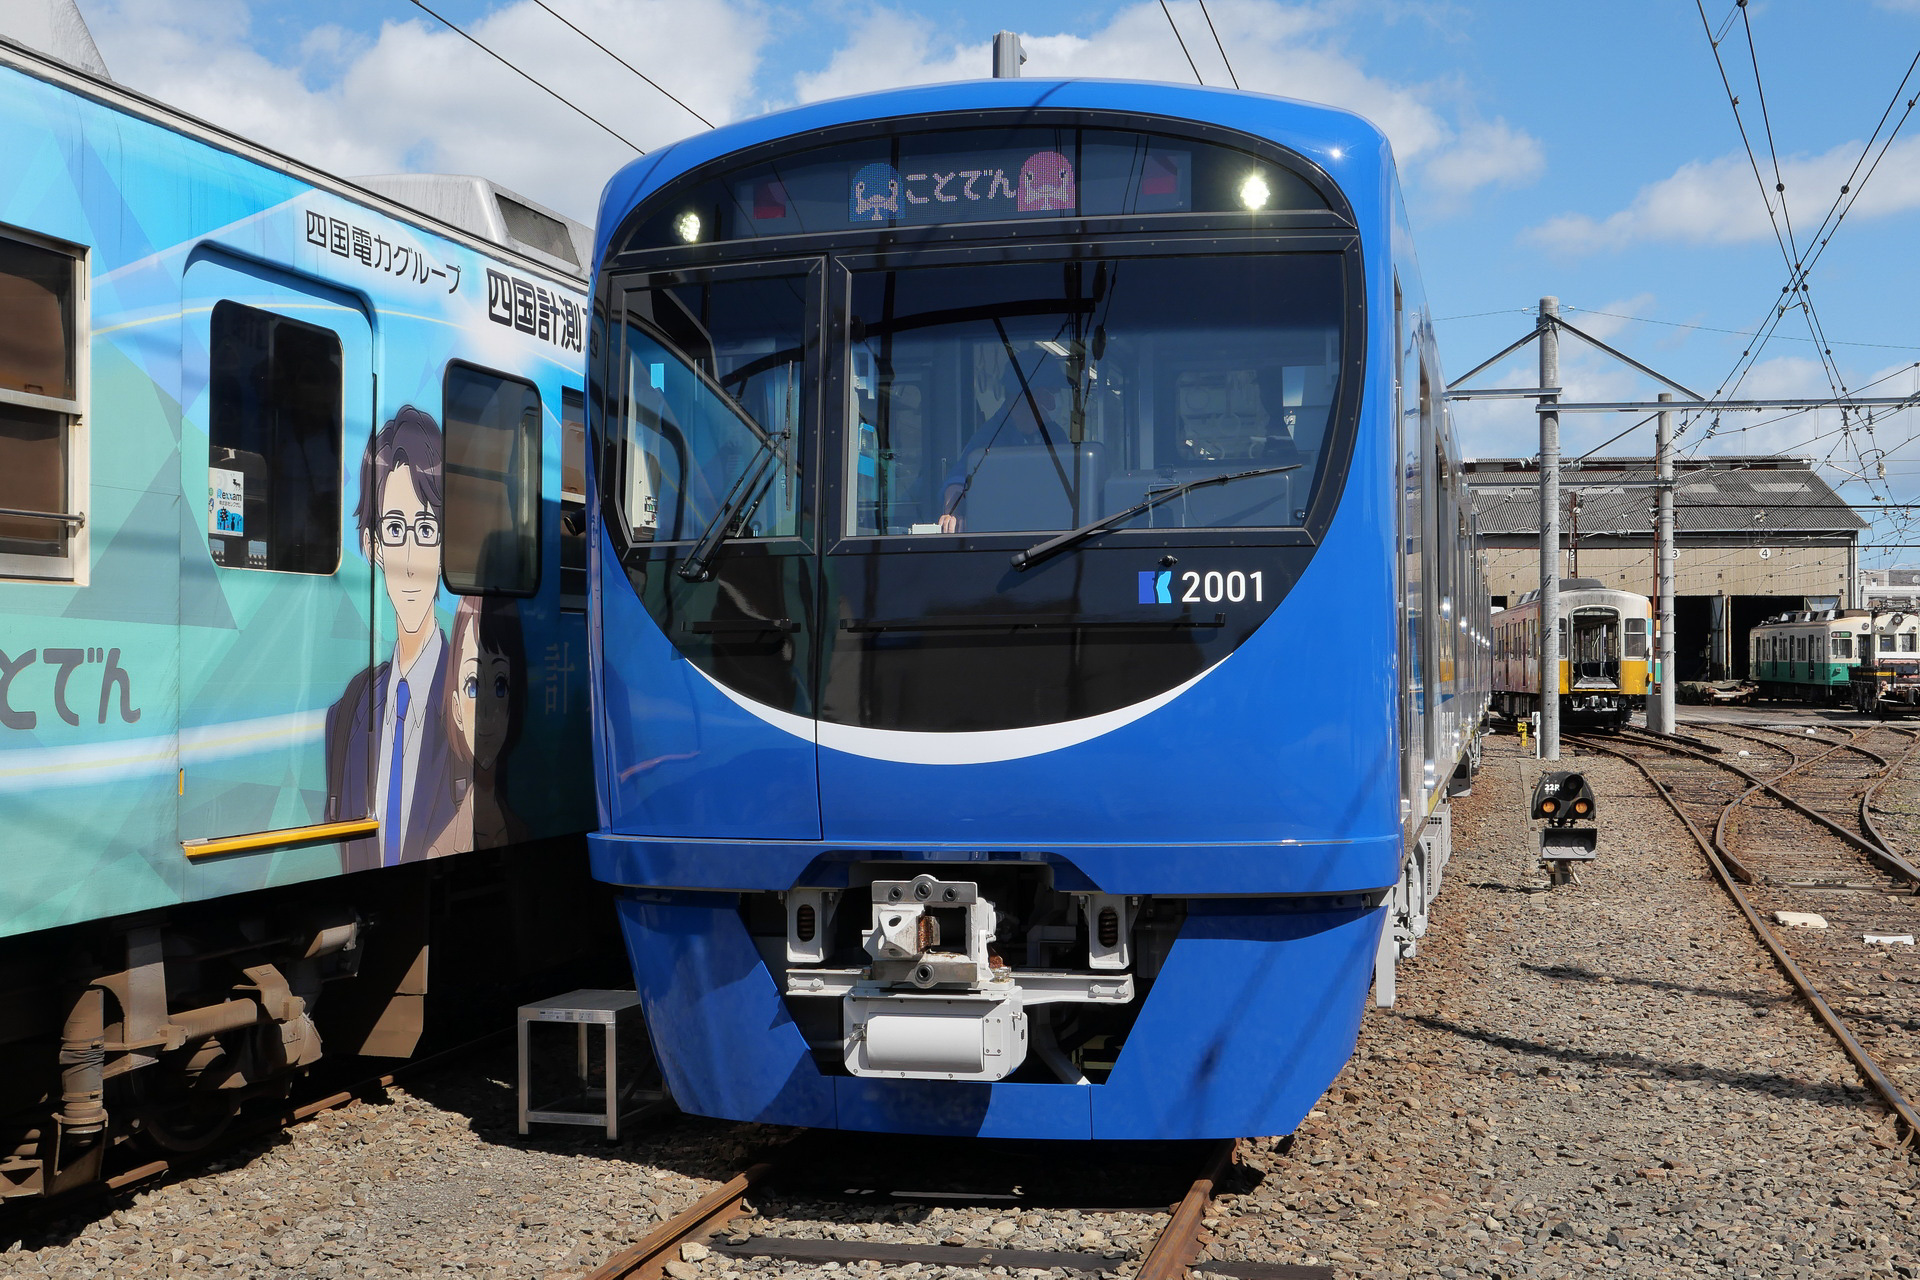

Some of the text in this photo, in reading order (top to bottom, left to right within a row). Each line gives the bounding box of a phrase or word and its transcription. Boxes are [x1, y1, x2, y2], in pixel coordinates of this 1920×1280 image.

[906, 168, 1017, 204] ことでん
[306, 210, 462, 294] 四国電力グループ
[487, 267, 588, 353] 四国計測
[1761, 549, 1768, 558] 4
[1181, 571, 1263, 603] 2001
[1544, 783, 1560, 792] 22R
